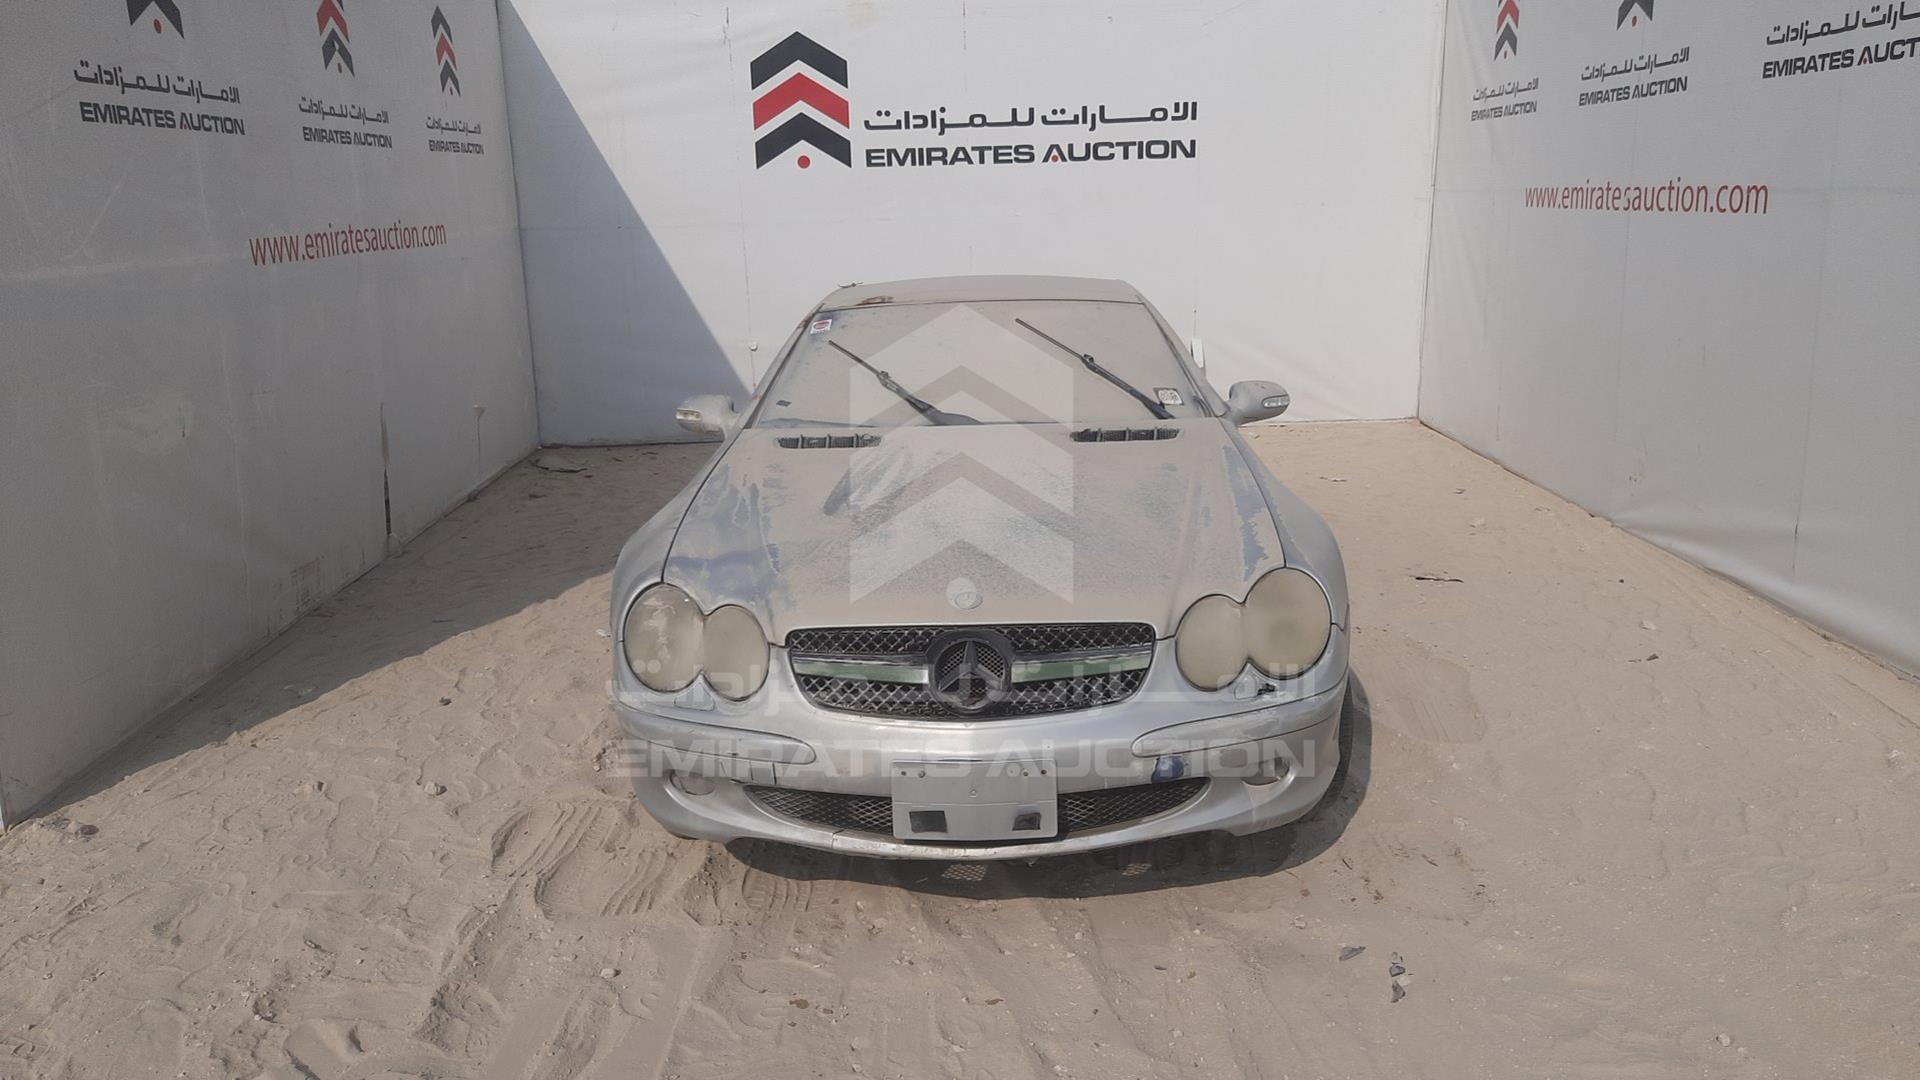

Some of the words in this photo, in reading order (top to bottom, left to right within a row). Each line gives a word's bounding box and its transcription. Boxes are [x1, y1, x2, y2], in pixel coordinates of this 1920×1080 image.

[1762, 49, 1854, 79] EMIRATES
[1857, 37, 1920, 66] AUCT
[1578, 86, 1630, 106] EMIRATES
[1631, 76, 1688, 98] AUCTION
[80, 101, 176, 129] EMIRATES
[180, 112, 245, 135] AUCTION
[1471, 106, 1503, 121] EMIRATES
[1503, 101, 1537, 117] AUCTION
[302, 126, 352, 145] EMIRATES
[353, 132, 392, 148] AUCTION
[428, 139, 460, 153] EMIRATES
[460, 142, 484, 155] AUCTION
[865, 144, 1035, 168] EMIRATES
[1042, 139, 1197, 163] AUCTION
[1525, 176, 1769, 214] www.emiratesauction.com
[249, 219, 447, 266] www.emiratesauction.com
